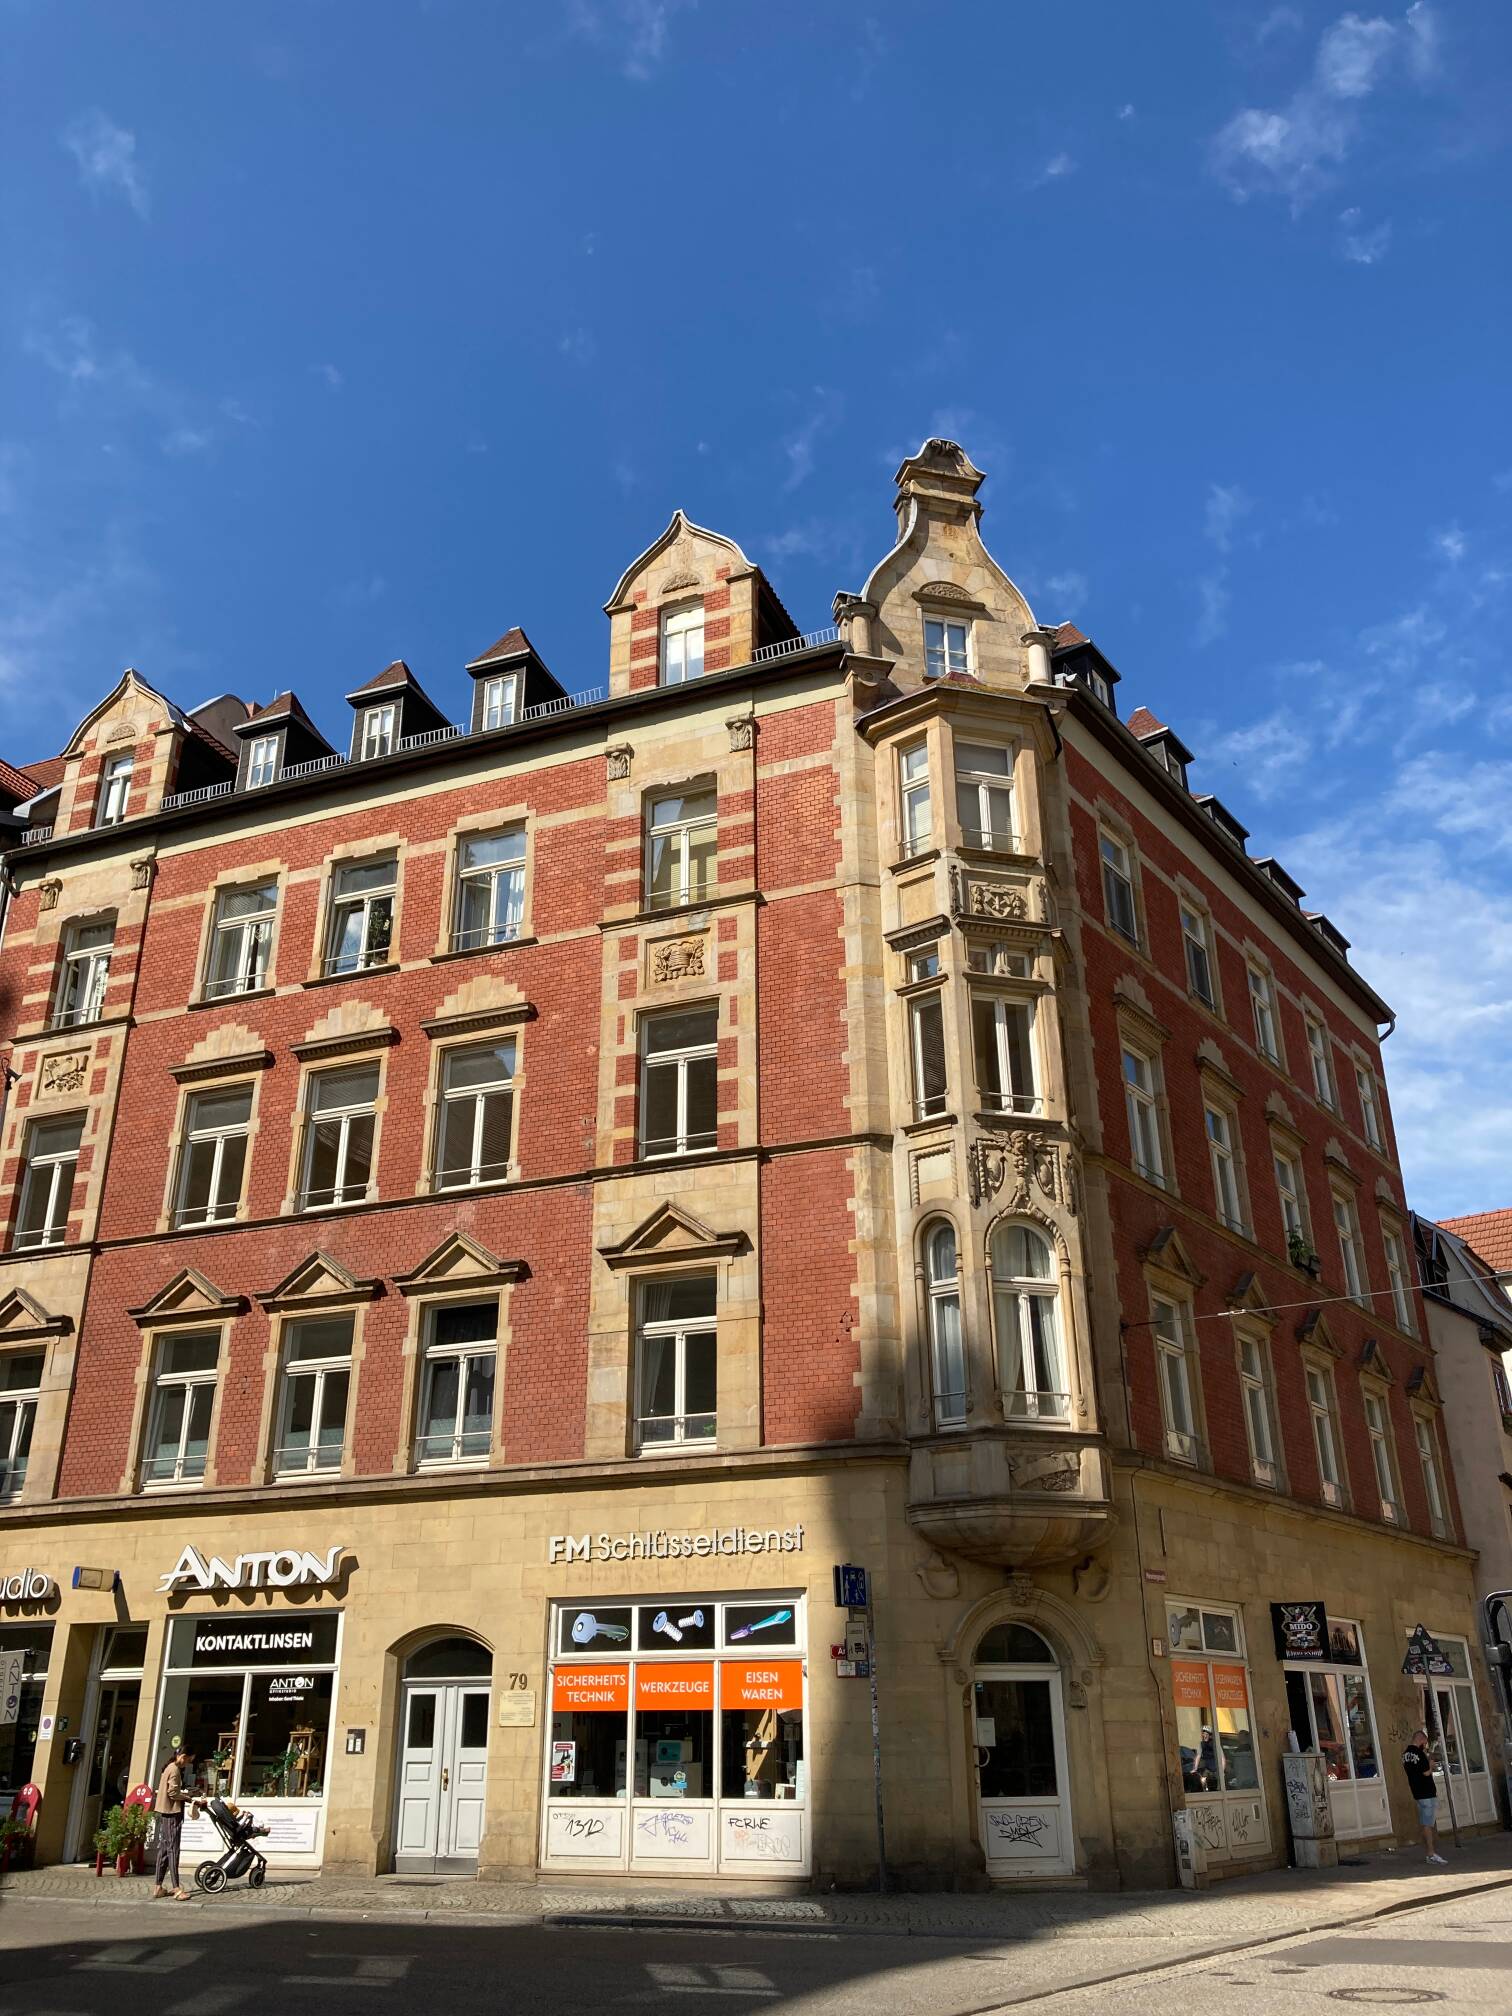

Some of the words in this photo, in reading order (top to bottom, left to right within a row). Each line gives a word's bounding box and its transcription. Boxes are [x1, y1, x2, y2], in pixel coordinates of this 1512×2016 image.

[550, 1534, 591, 1563] FM
[598, 1523, 804, 1561] Schlüsseldienst
[155, 1544, 348, 1592] ANTON
[196, 1632, 313, 1651] KONTAKTLINSEN
[269, 1676, 314, 1689] ANTON
[509, 1673, 528, 1690] 79
[556, 1674, 626, 1687] SICHERHEITS
[746, 1671, 779, 1684] EISEN
[4, 1658, 20, 1721] ANTON
[640, 1681, 710, 1693] WERKZEUGE
[566, 1691, 615, 1703] TECHNIK
[741, 1688, 783, 1700] WAREN
